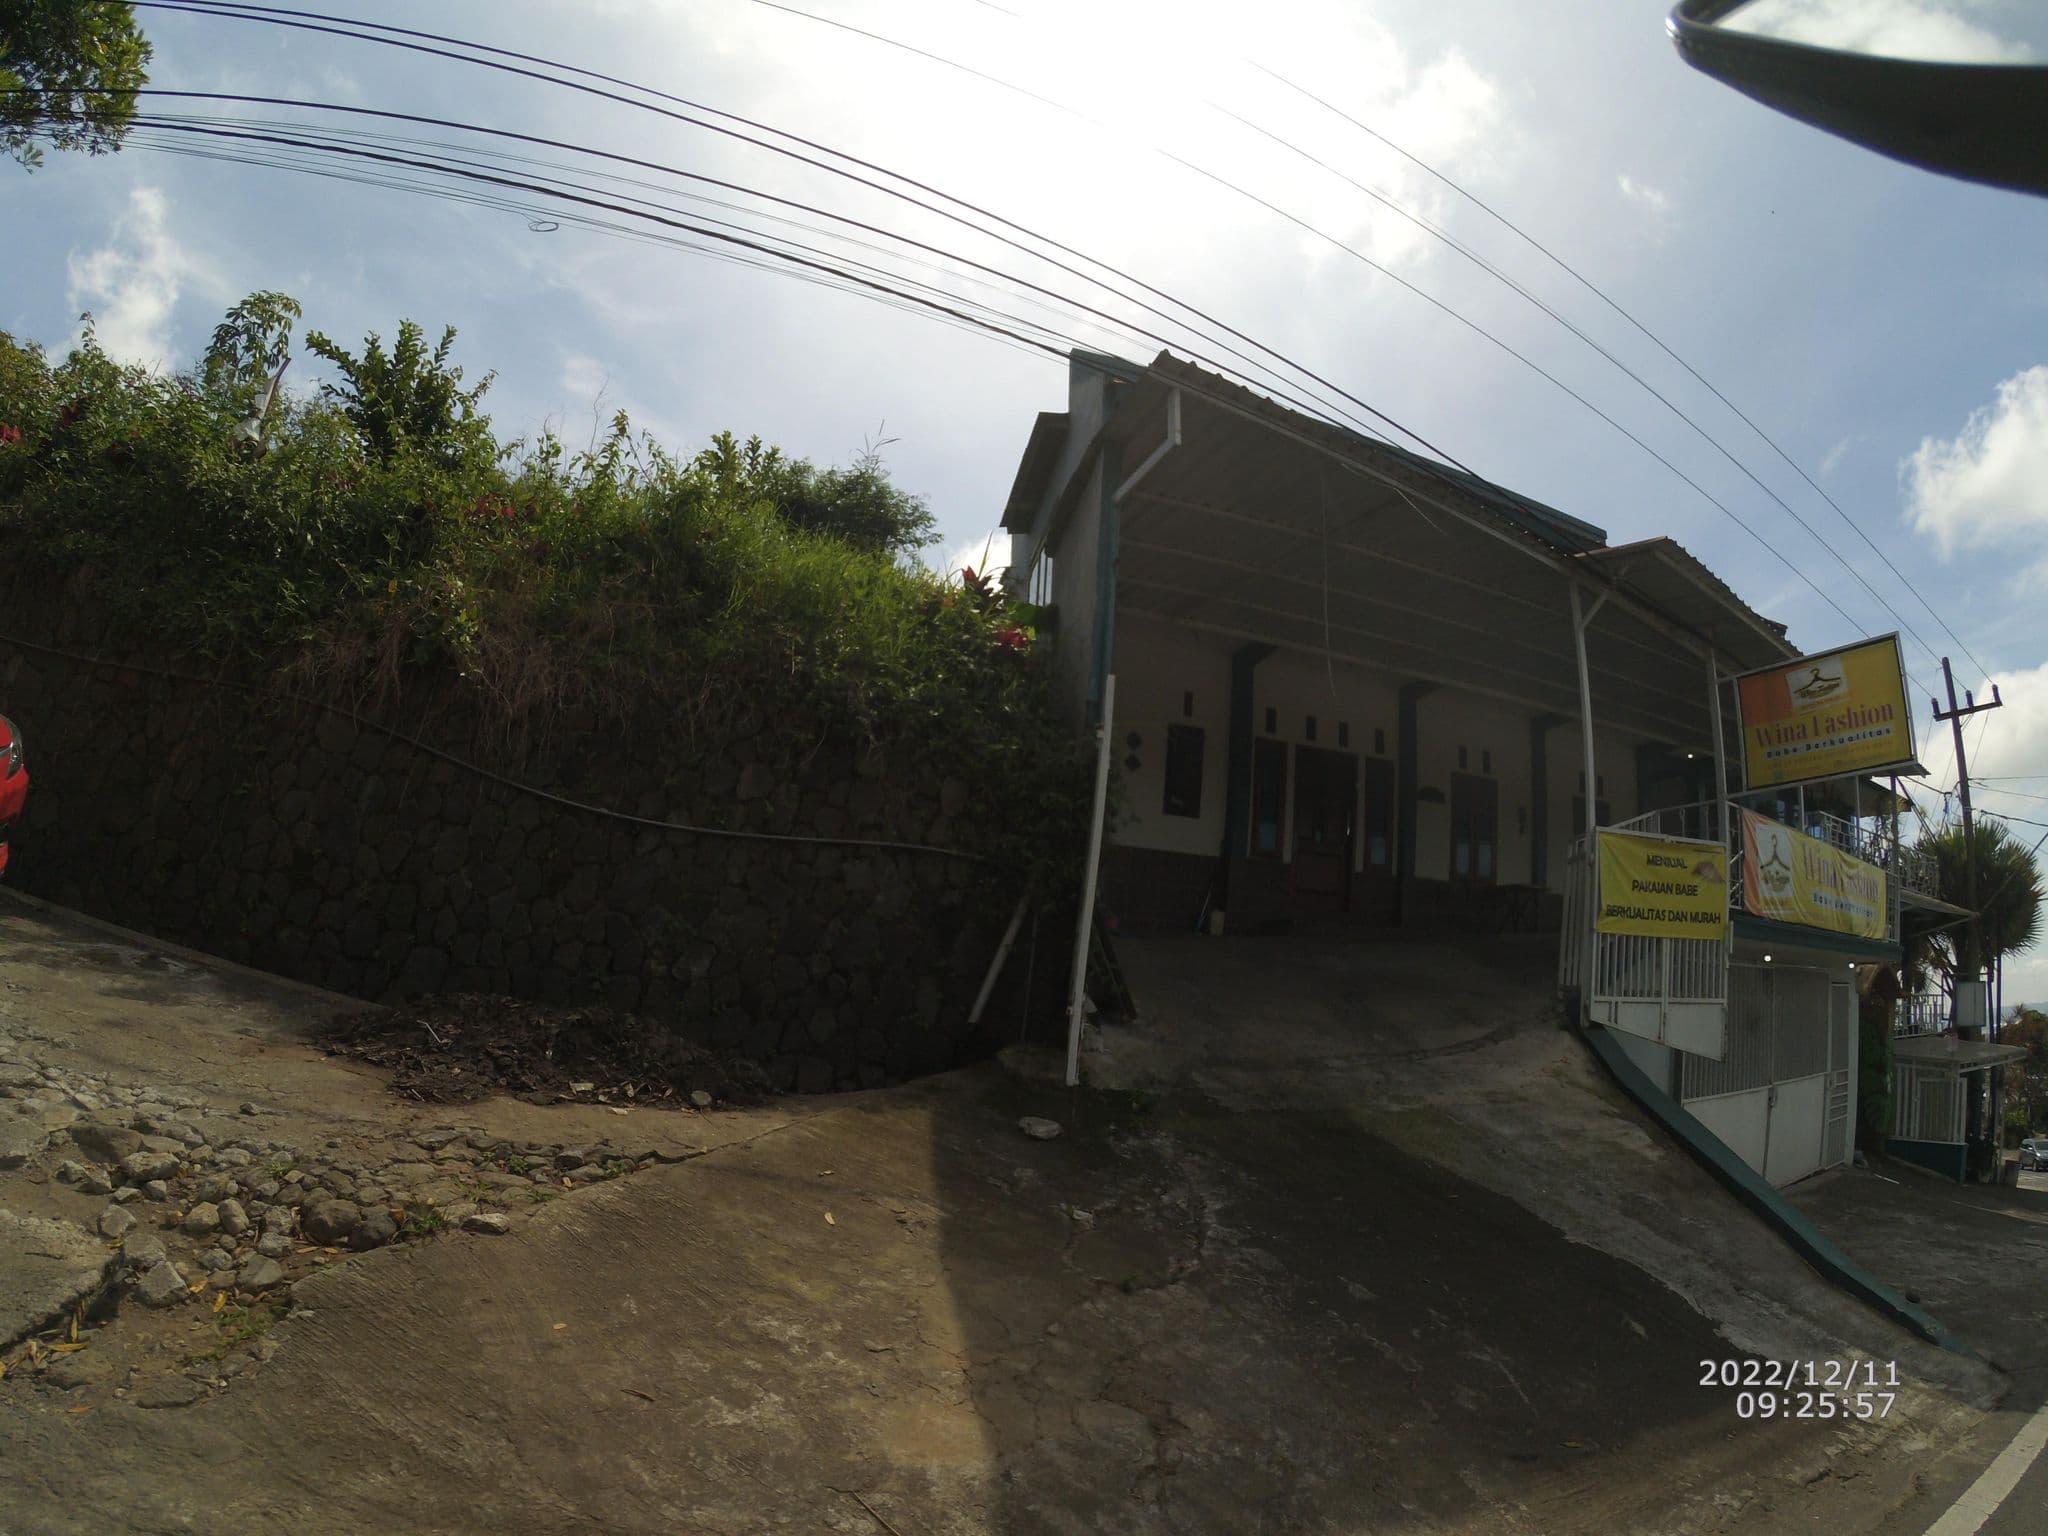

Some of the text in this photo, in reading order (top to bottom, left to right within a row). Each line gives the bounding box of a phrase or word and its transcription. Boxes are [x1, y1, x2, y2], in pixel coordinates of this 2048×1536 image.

[1754, 722, 1806, 747] Wina
[1631, 879, 1698, 896] PAKAIAN BABE
[1606, 904, 1721, 924] BERKUALITAS DAN MURAH
